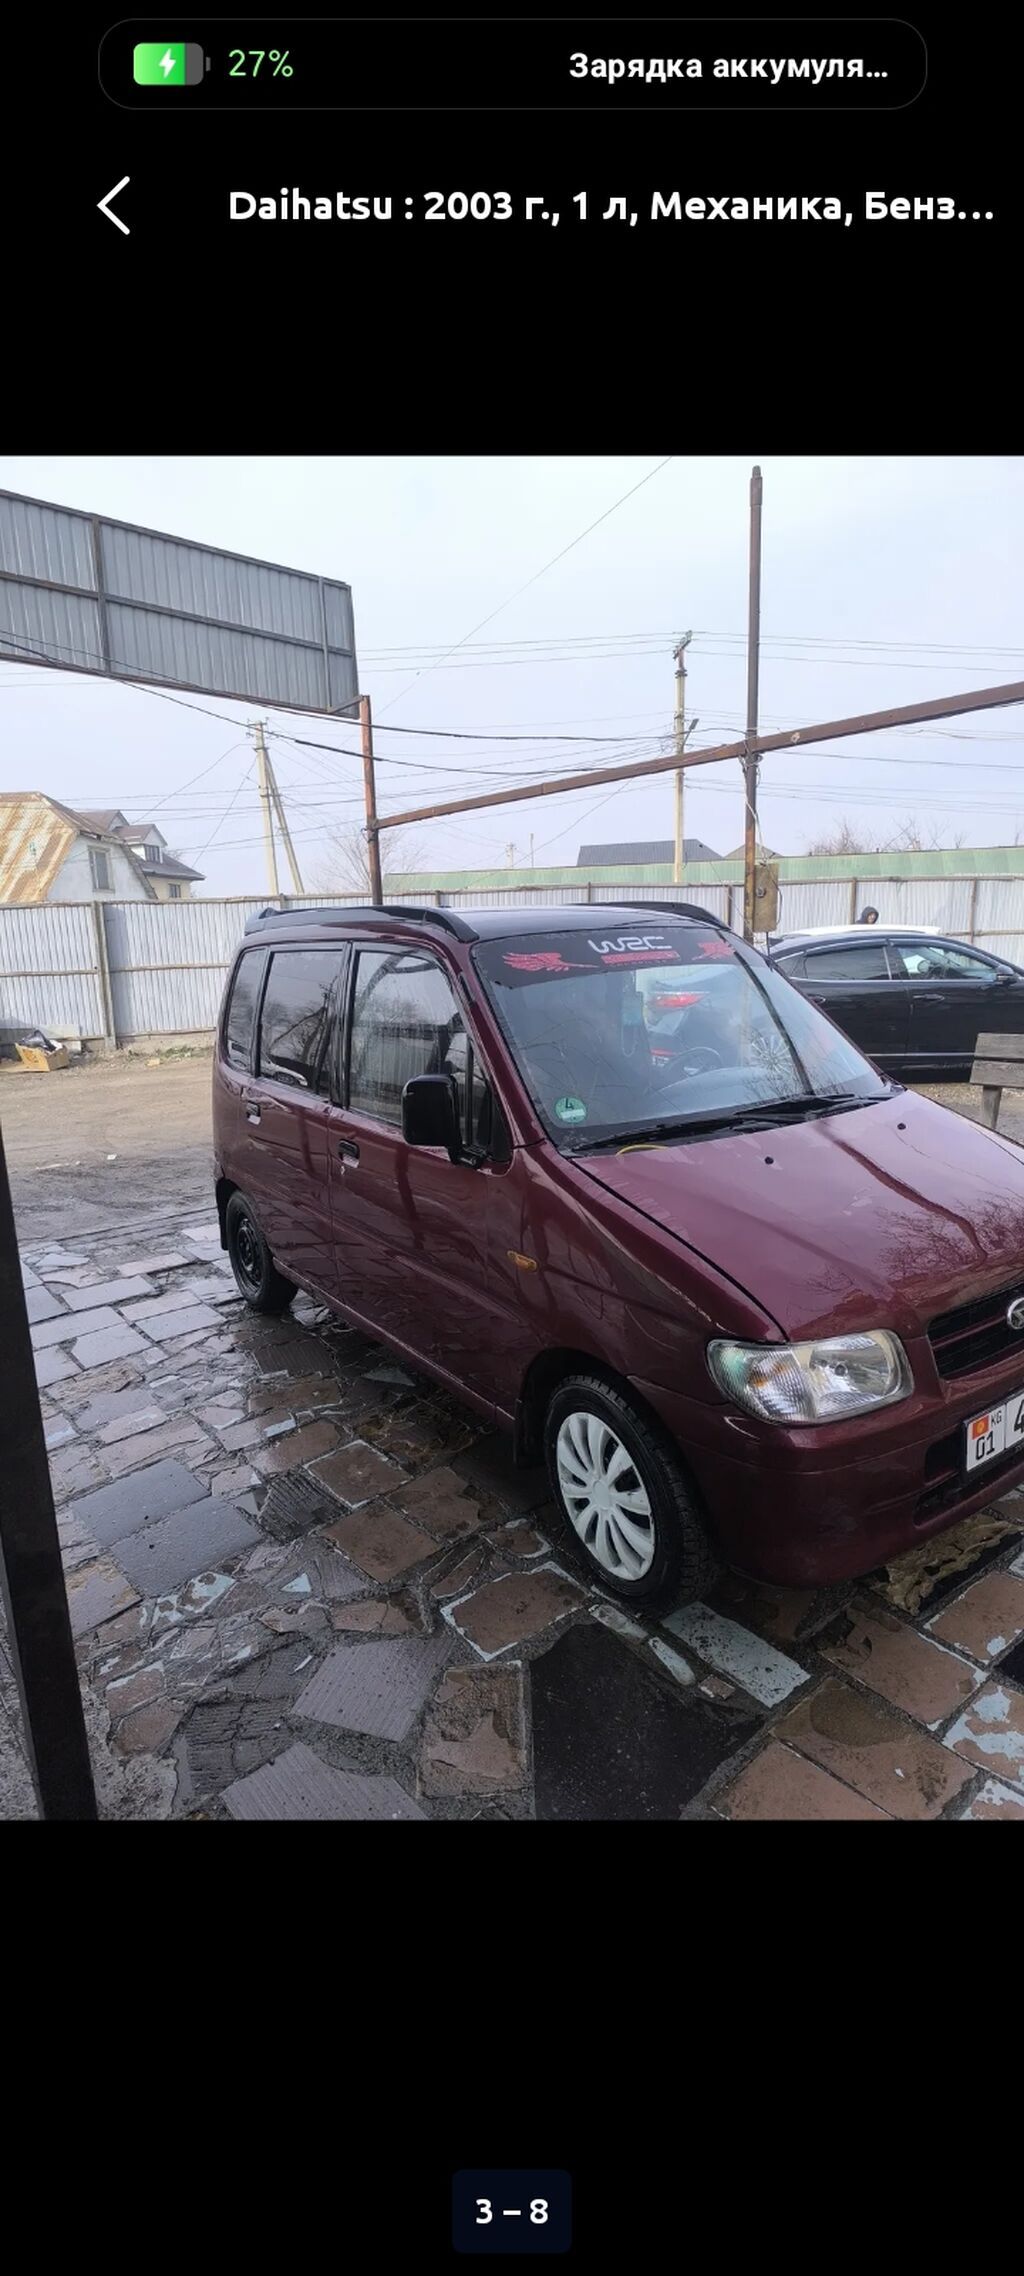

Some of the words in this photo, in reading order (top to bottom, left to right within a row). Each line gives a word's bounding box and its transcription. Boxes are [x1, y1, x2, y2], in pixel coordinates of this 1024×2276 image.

[587, 936, 672, 953] WRC
[991, 1410, 1002, 1427] KG
[976, 1430, 995, 1460] 01
